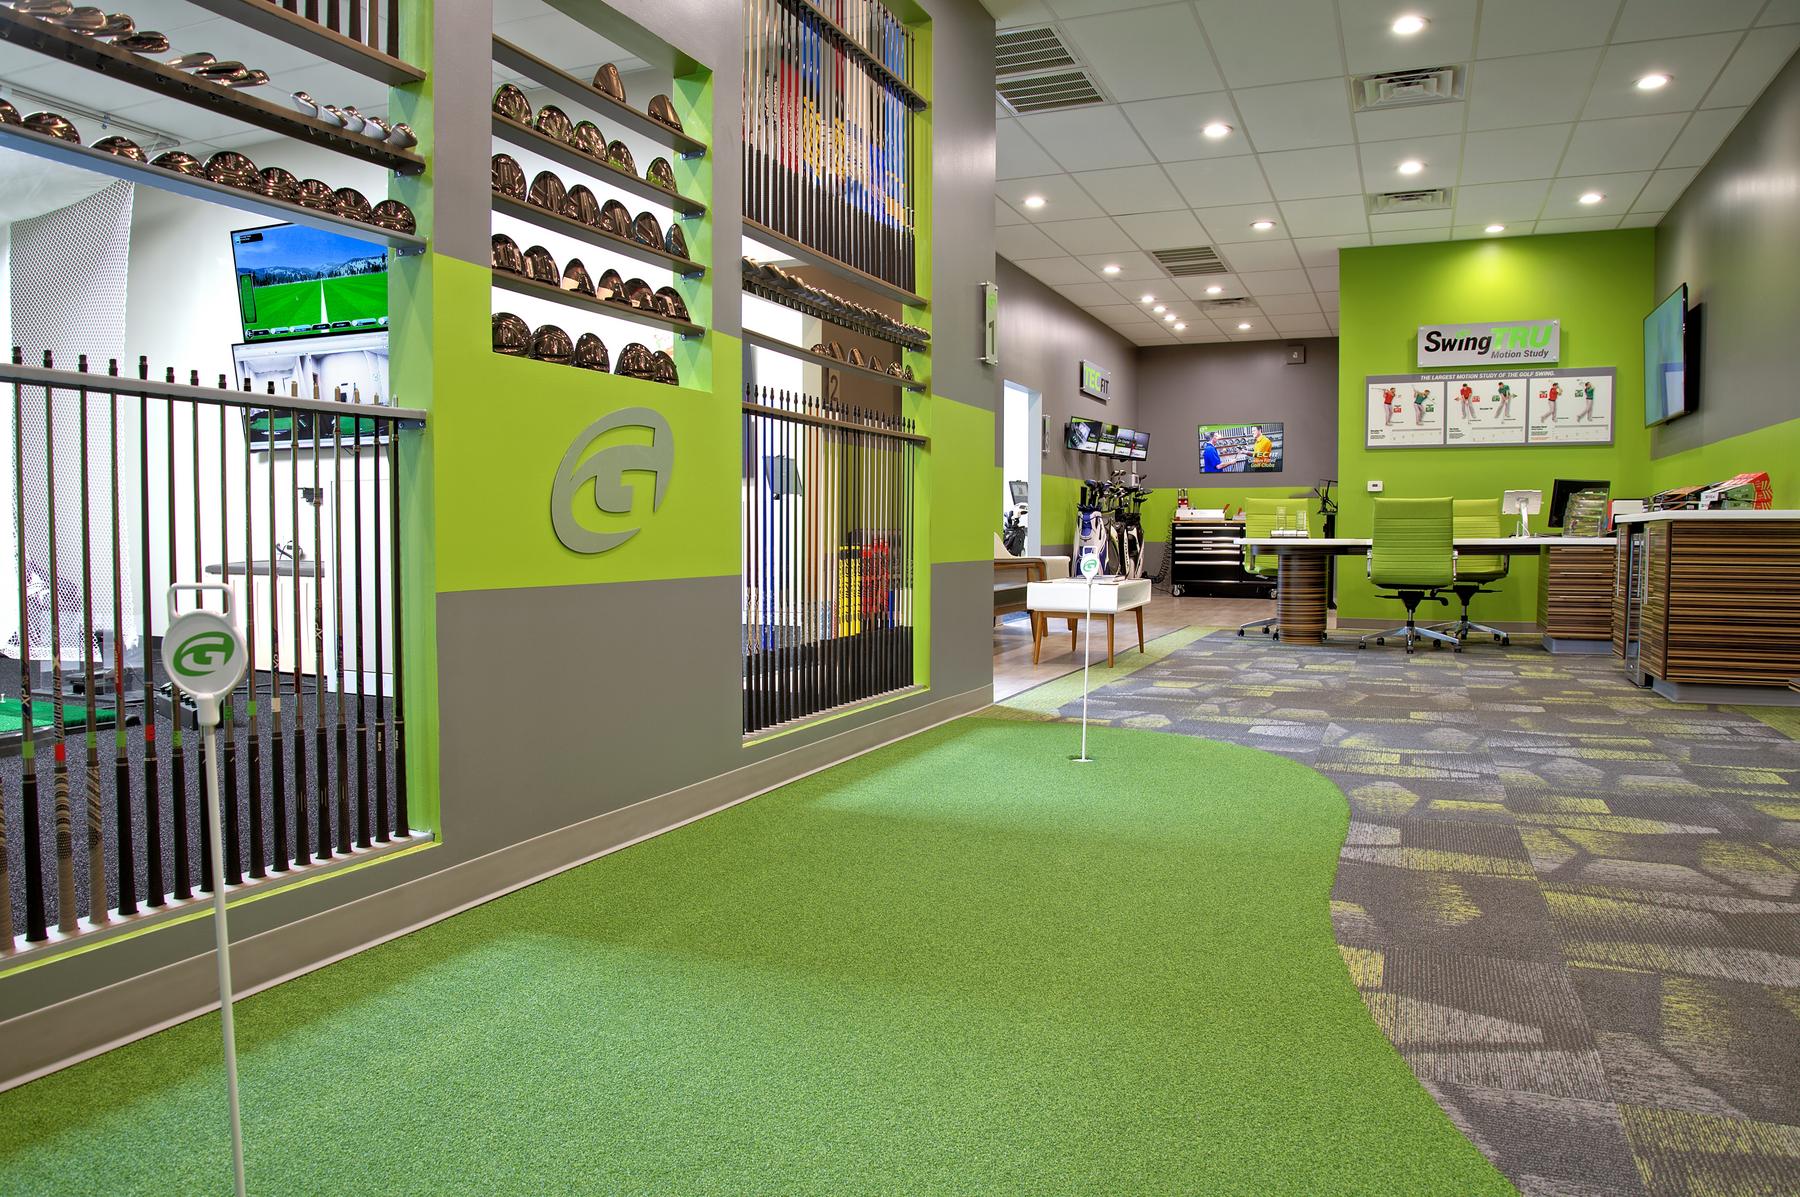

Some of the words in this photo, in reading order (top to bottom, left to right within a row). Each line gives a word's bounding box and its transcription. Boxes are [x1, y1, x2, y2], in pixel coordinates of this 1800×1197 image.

[988, 320, 995, 355] 1
[1491, 350, 1521, 359] Motion
[1523, 348, 1549, 358] Study
[830, 374, 839, 401] 2
